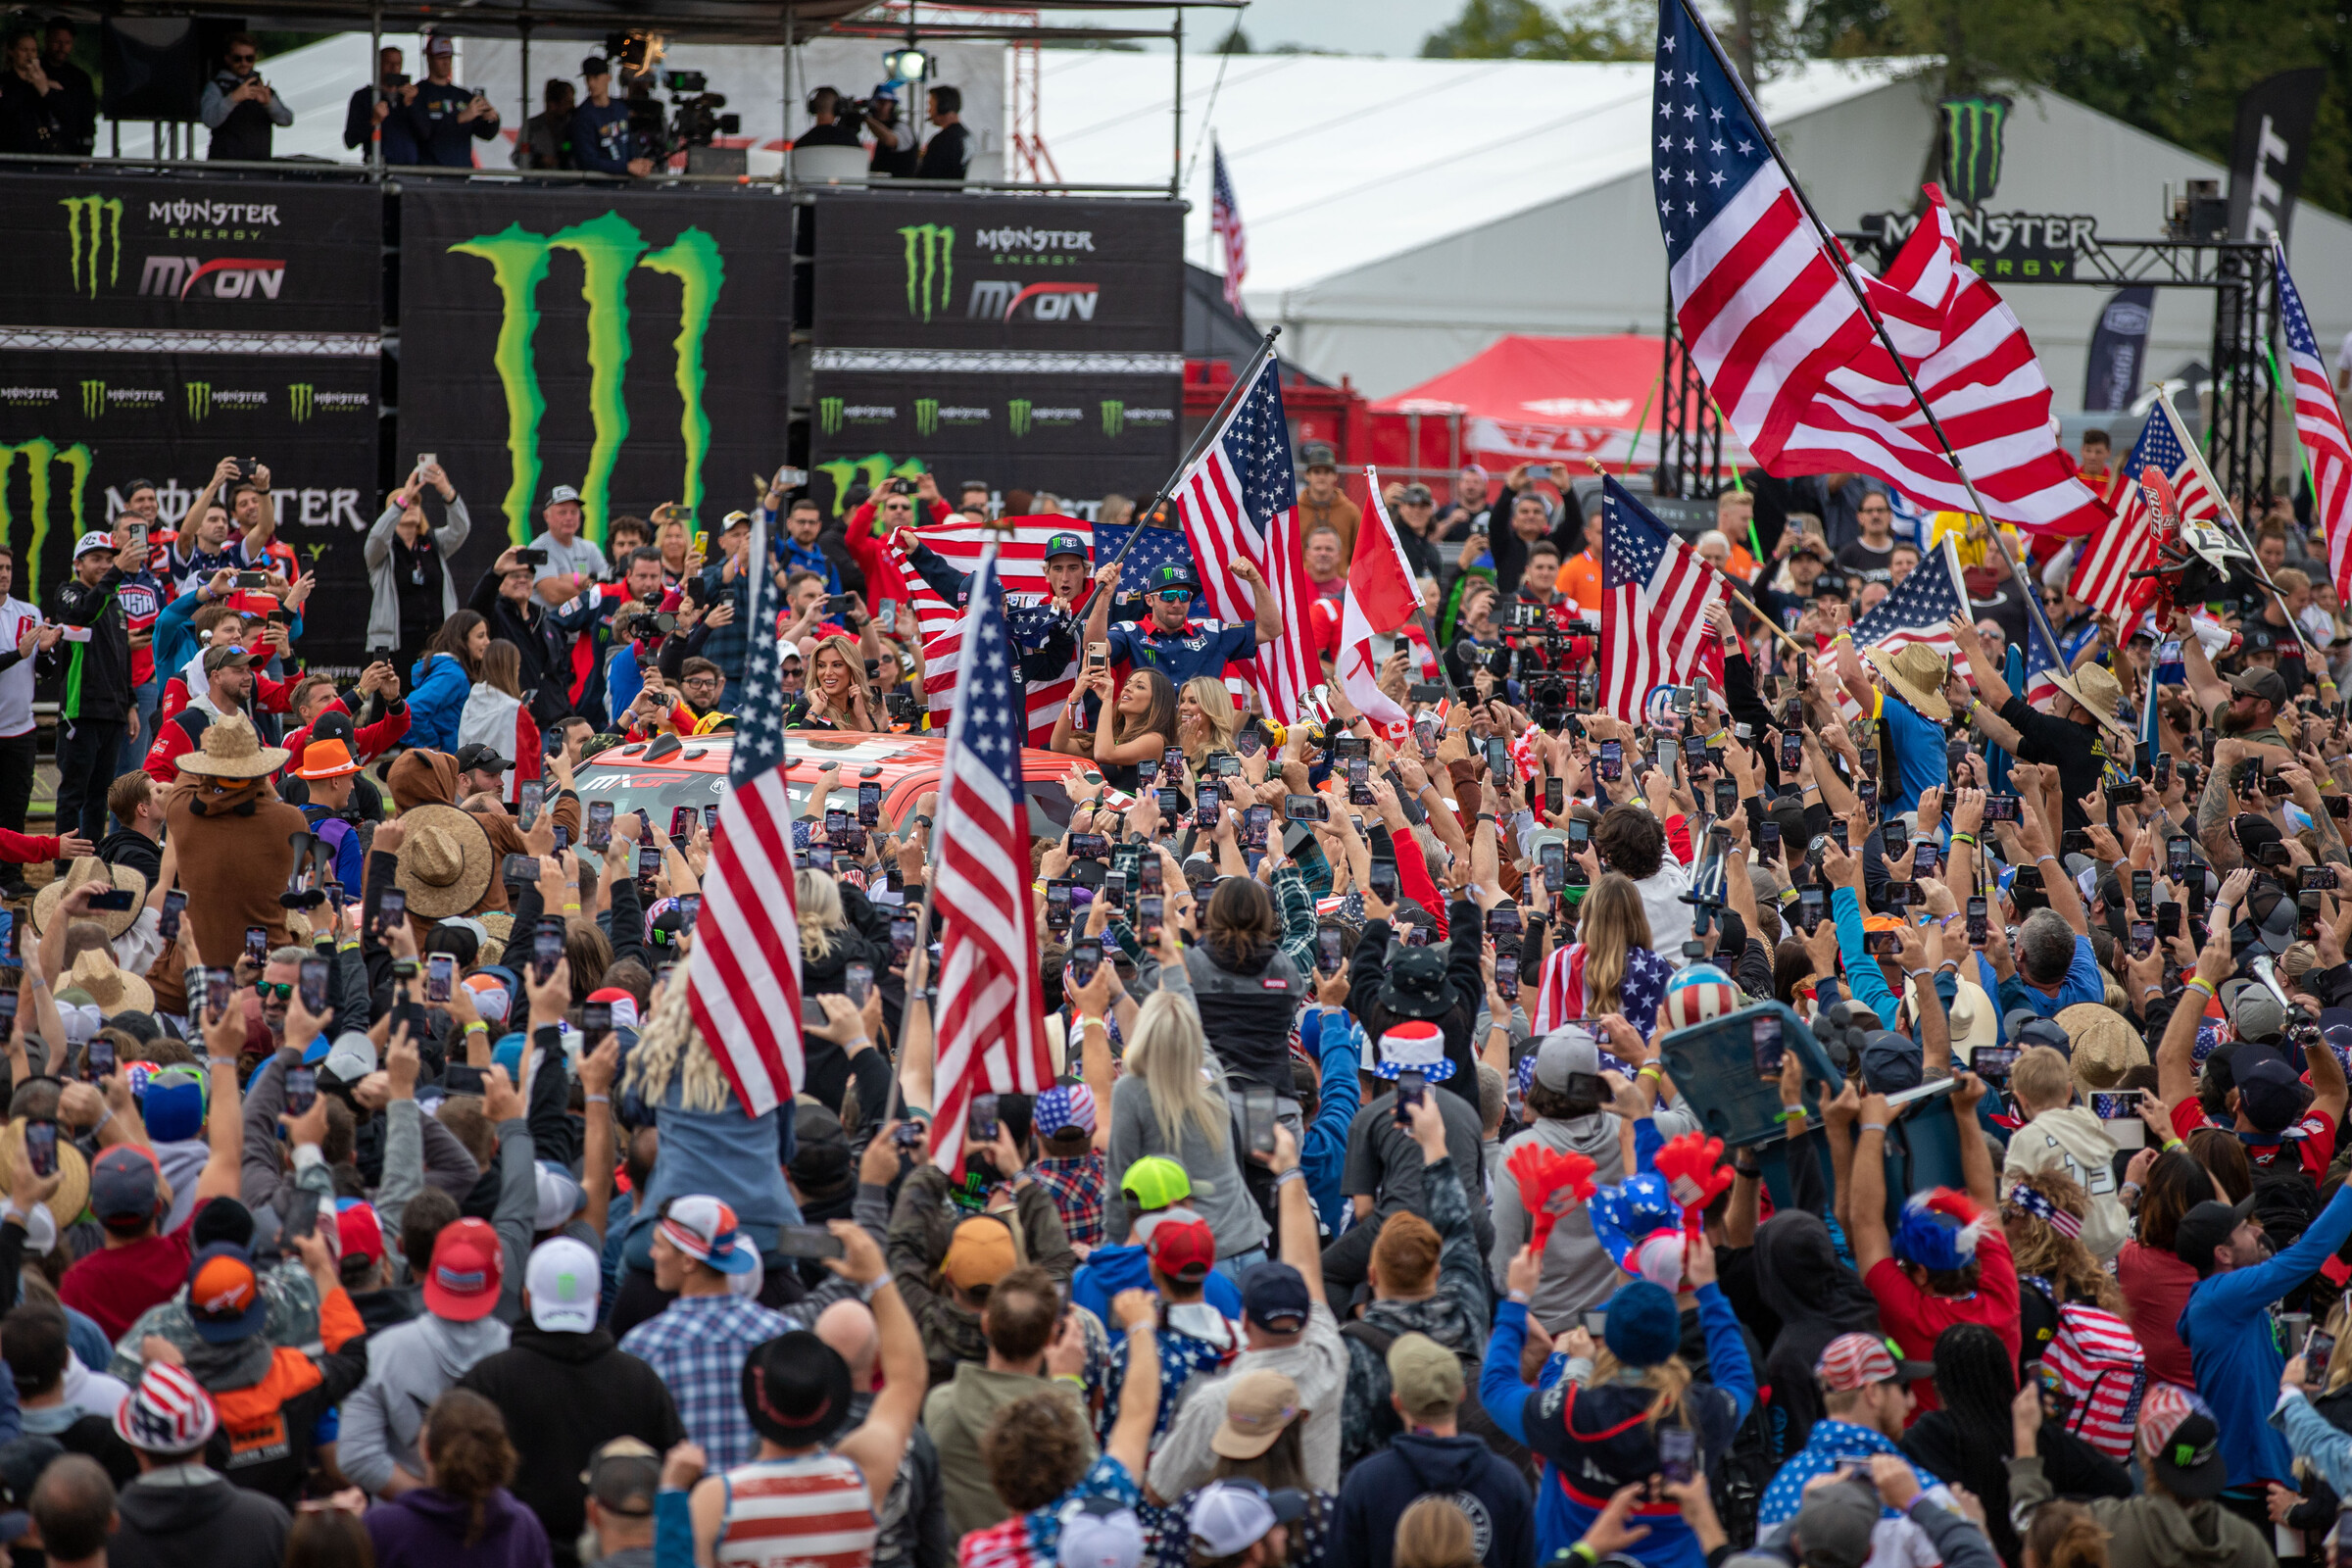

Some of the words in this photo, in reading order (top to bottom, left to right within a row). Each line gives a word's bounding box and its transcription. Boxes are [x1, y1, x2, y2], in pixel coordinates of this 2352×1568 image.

[149, 199, 281, 226] MONSTER
[170, 228, 261, 240] ENERGY
[976, 226, 1096, 252] MONSTER
[1884, 208, 2101, 254] MNSTER
[994, 254, 1077, 266] ENERGY
[1970, 259, 2066, 276] ERGY
[1, 386, 59, 400] MONSTER
[107, 387, 165, 402] MONSTER
[212, 389, 268, 404] MONSTER
[314, 391, 369, 406] MONSTER
[105, 478, 367, 532] MOTER
[2145, 488, 2162, 539] KLOTZ
[118, 593, 155, 616] USA
[1183, 635, 1208, 652] USA
